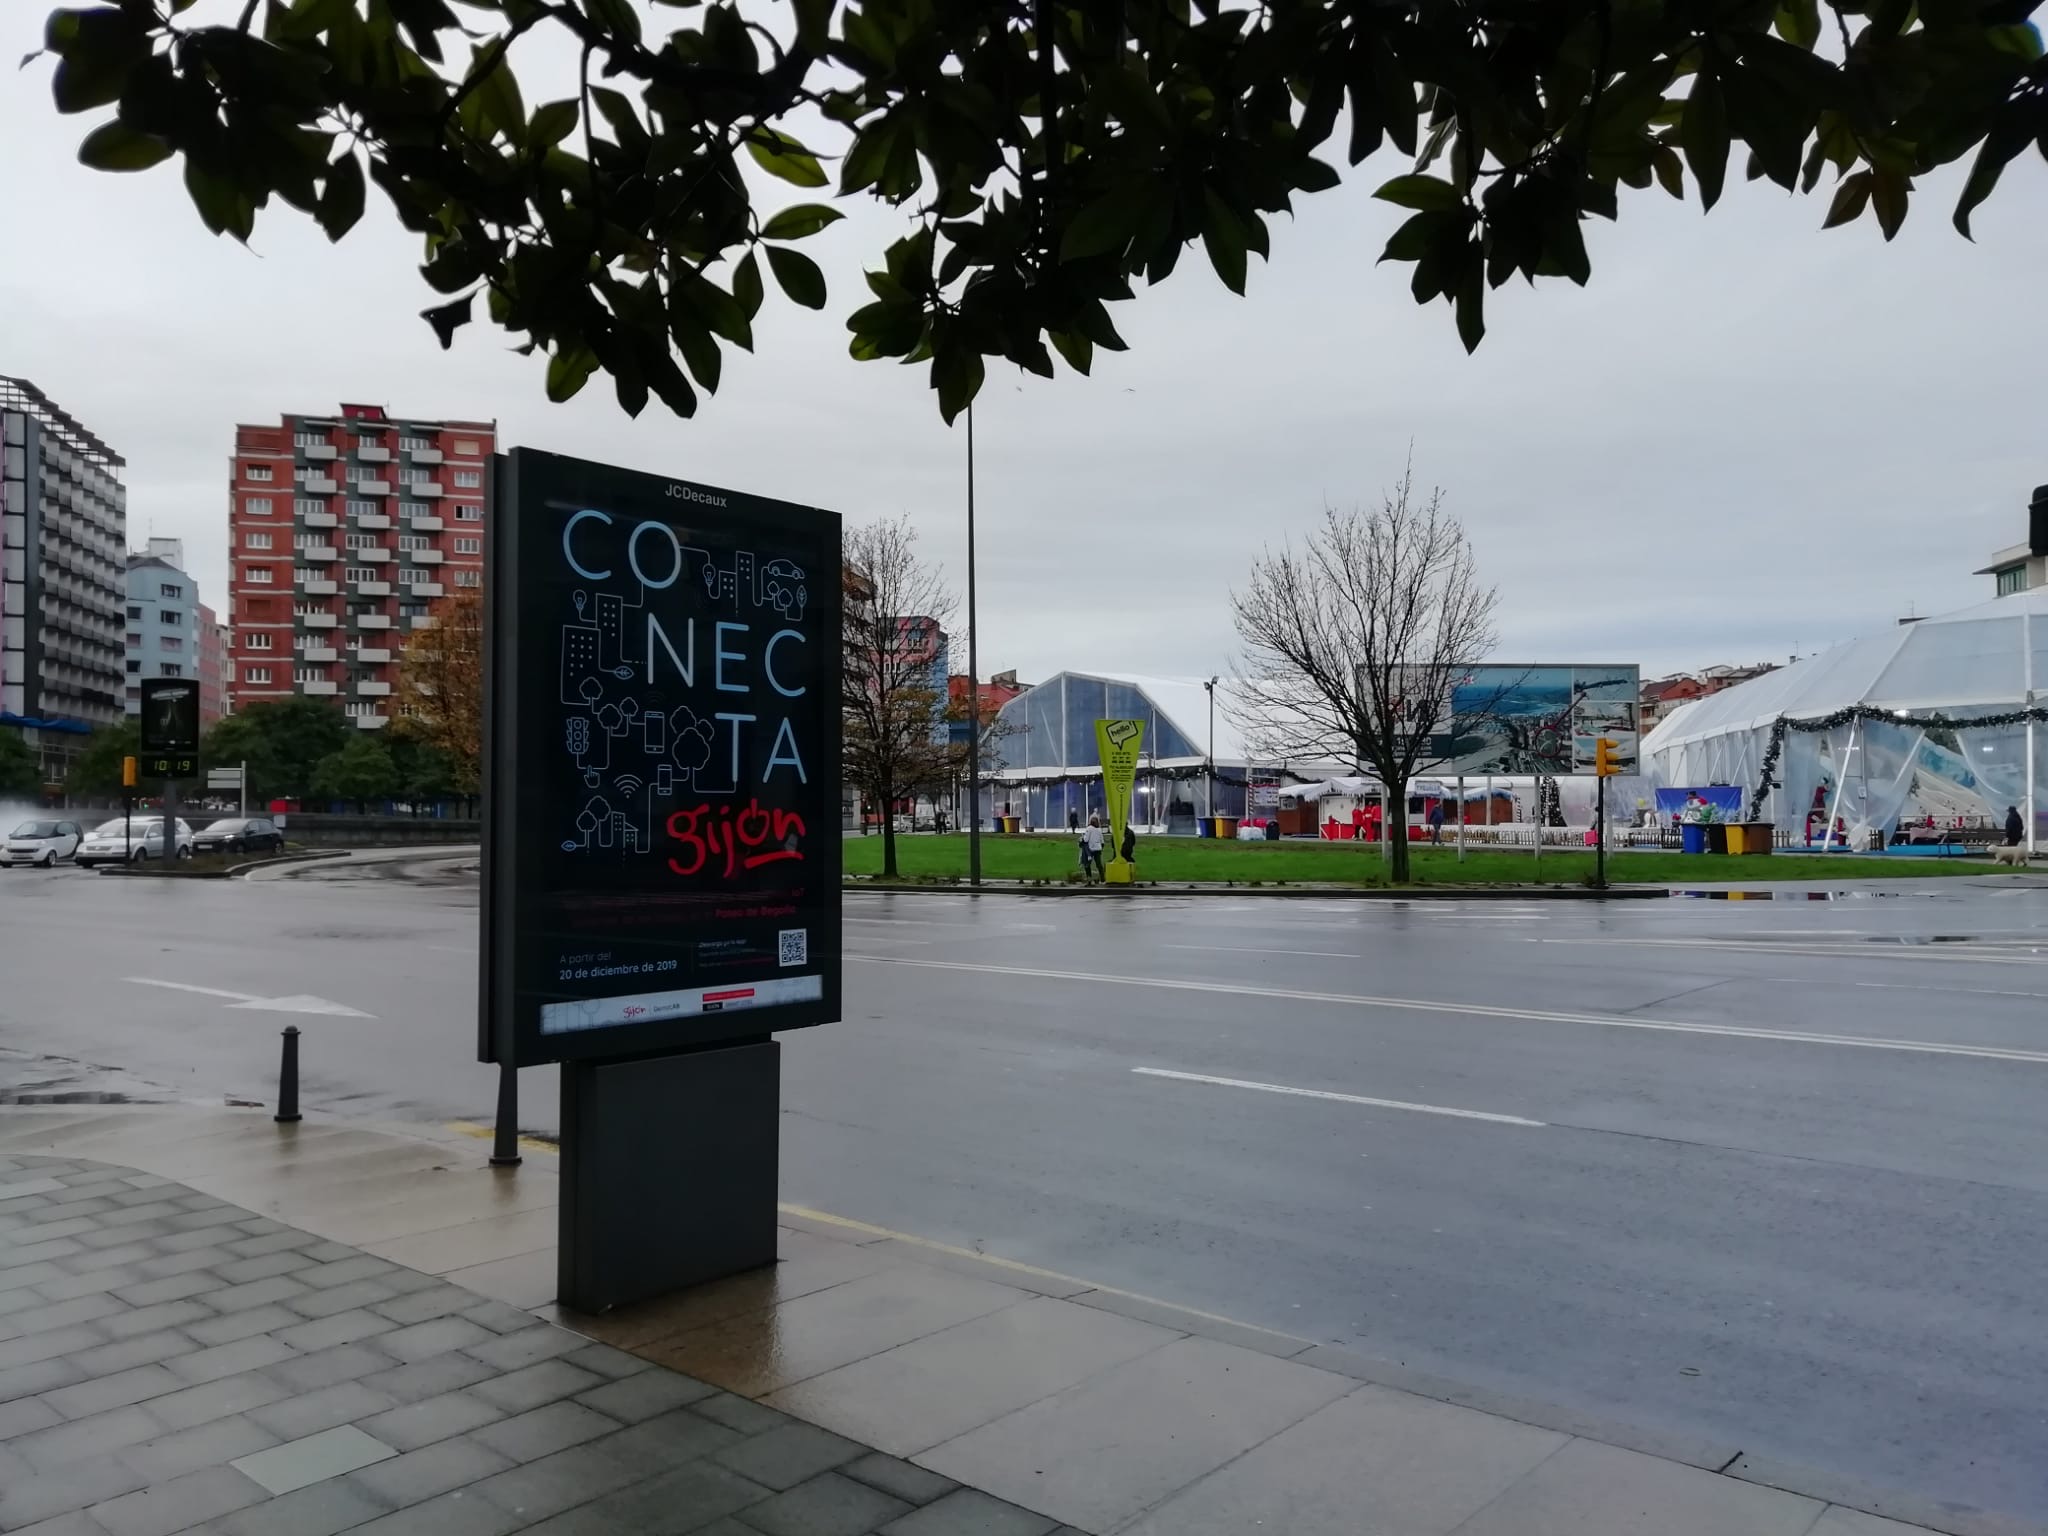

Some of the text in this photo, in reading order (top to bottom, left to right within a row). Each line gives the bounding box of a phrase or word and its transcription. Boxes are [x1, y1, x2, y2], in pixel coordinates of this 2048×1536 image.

[665, 484, 728, 508] JCDecaux
[559, 951, 612, 966] A partir del
[559, 959, 678, 981] 20 de diciembre de 2019
